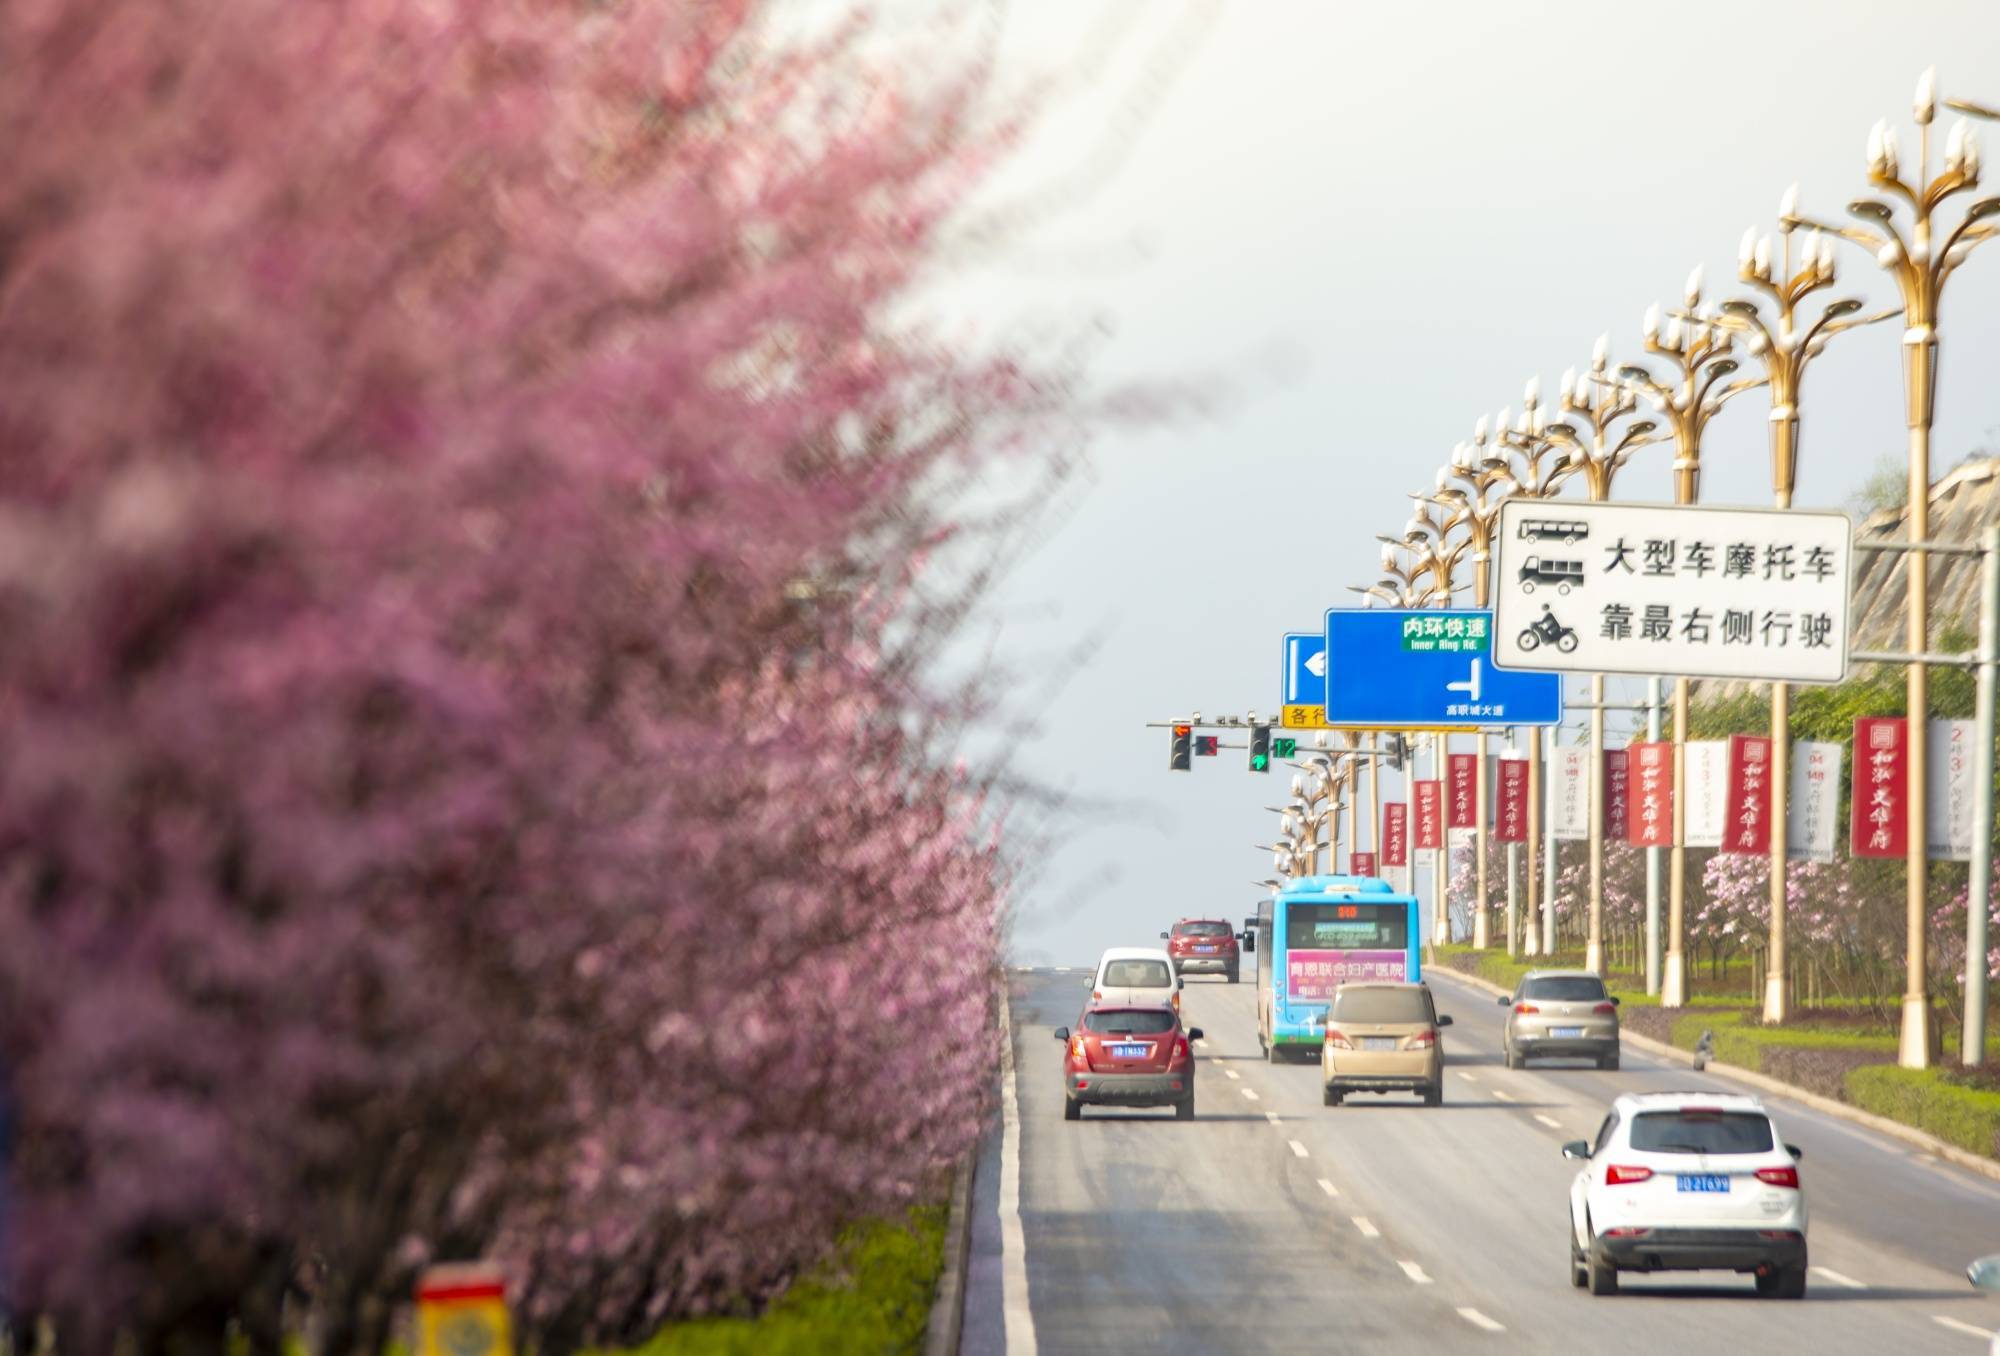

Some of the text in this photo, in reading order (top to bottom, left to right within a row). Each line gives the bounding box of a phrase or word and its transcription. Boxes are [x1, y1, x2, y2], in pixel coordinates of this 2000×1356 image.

[1602, 537, 1836, 583] 大型车摩托车
[1403, 617, 1486, 638] 内环快速
[1600, 603, 1832, 648] 靠最右侧行驶
[1411, 639, 1478, 652] Inner Ring Rd.
[1446, 704, 1504, 716] 高职城大道
[1274, 738, 1296, 758] 12
